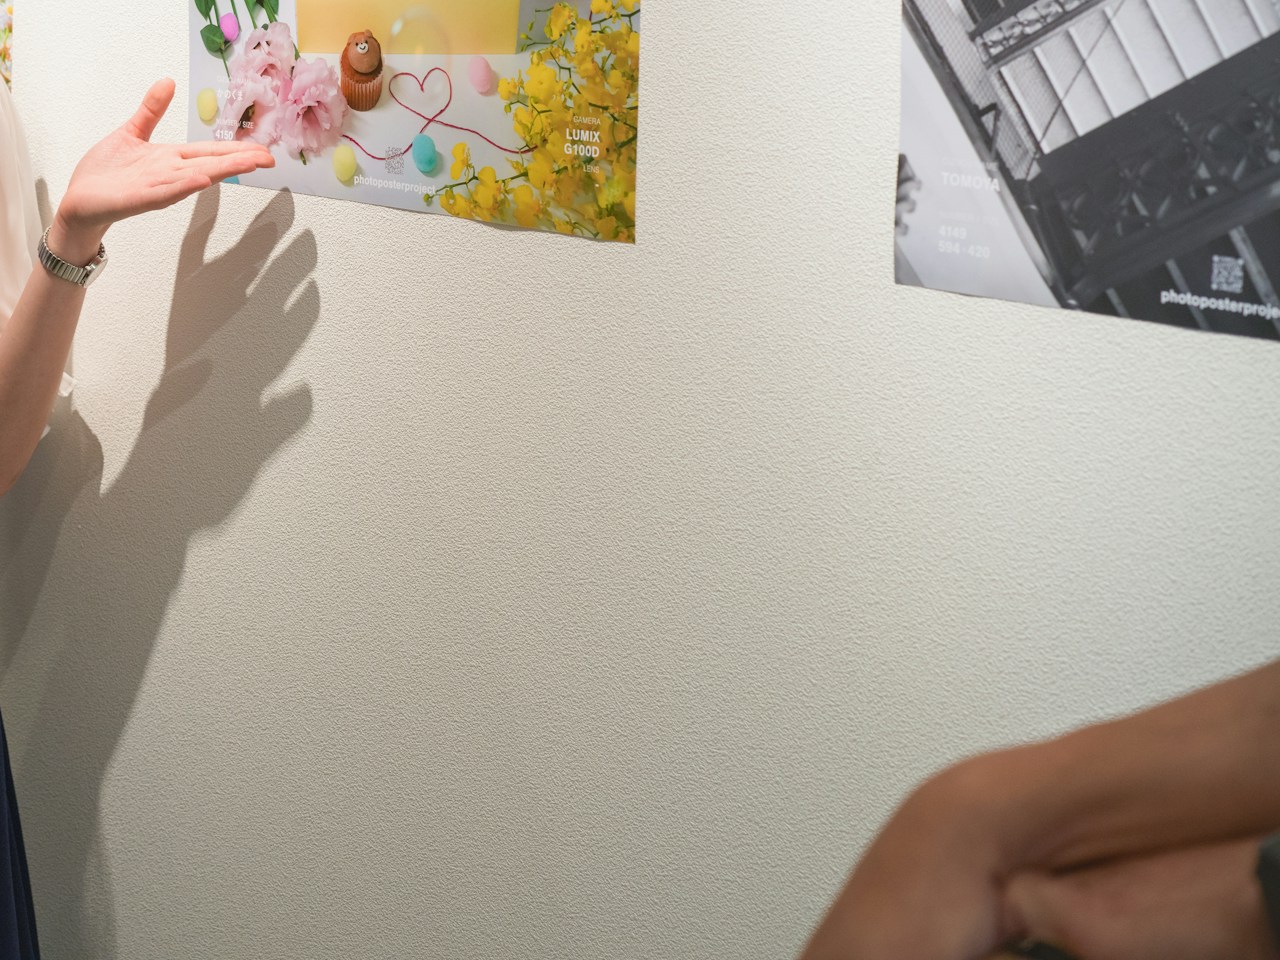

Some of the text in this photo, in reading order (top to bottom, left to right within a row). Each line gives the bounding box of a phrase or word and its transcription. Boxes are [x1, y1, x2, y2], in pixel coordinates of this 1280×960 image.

[215, 129, 234, 141] 4150
[565, 127, 600, 143] LUMIX
[564, 142, 600, 158] G100D
[583, 164, 600, 174] LENS
[354, 174, 436, 194] photoposterproject
[941, 171, 1000, 192] TOMOYA
[1160, 288, 1280, 321] photoposterproje
